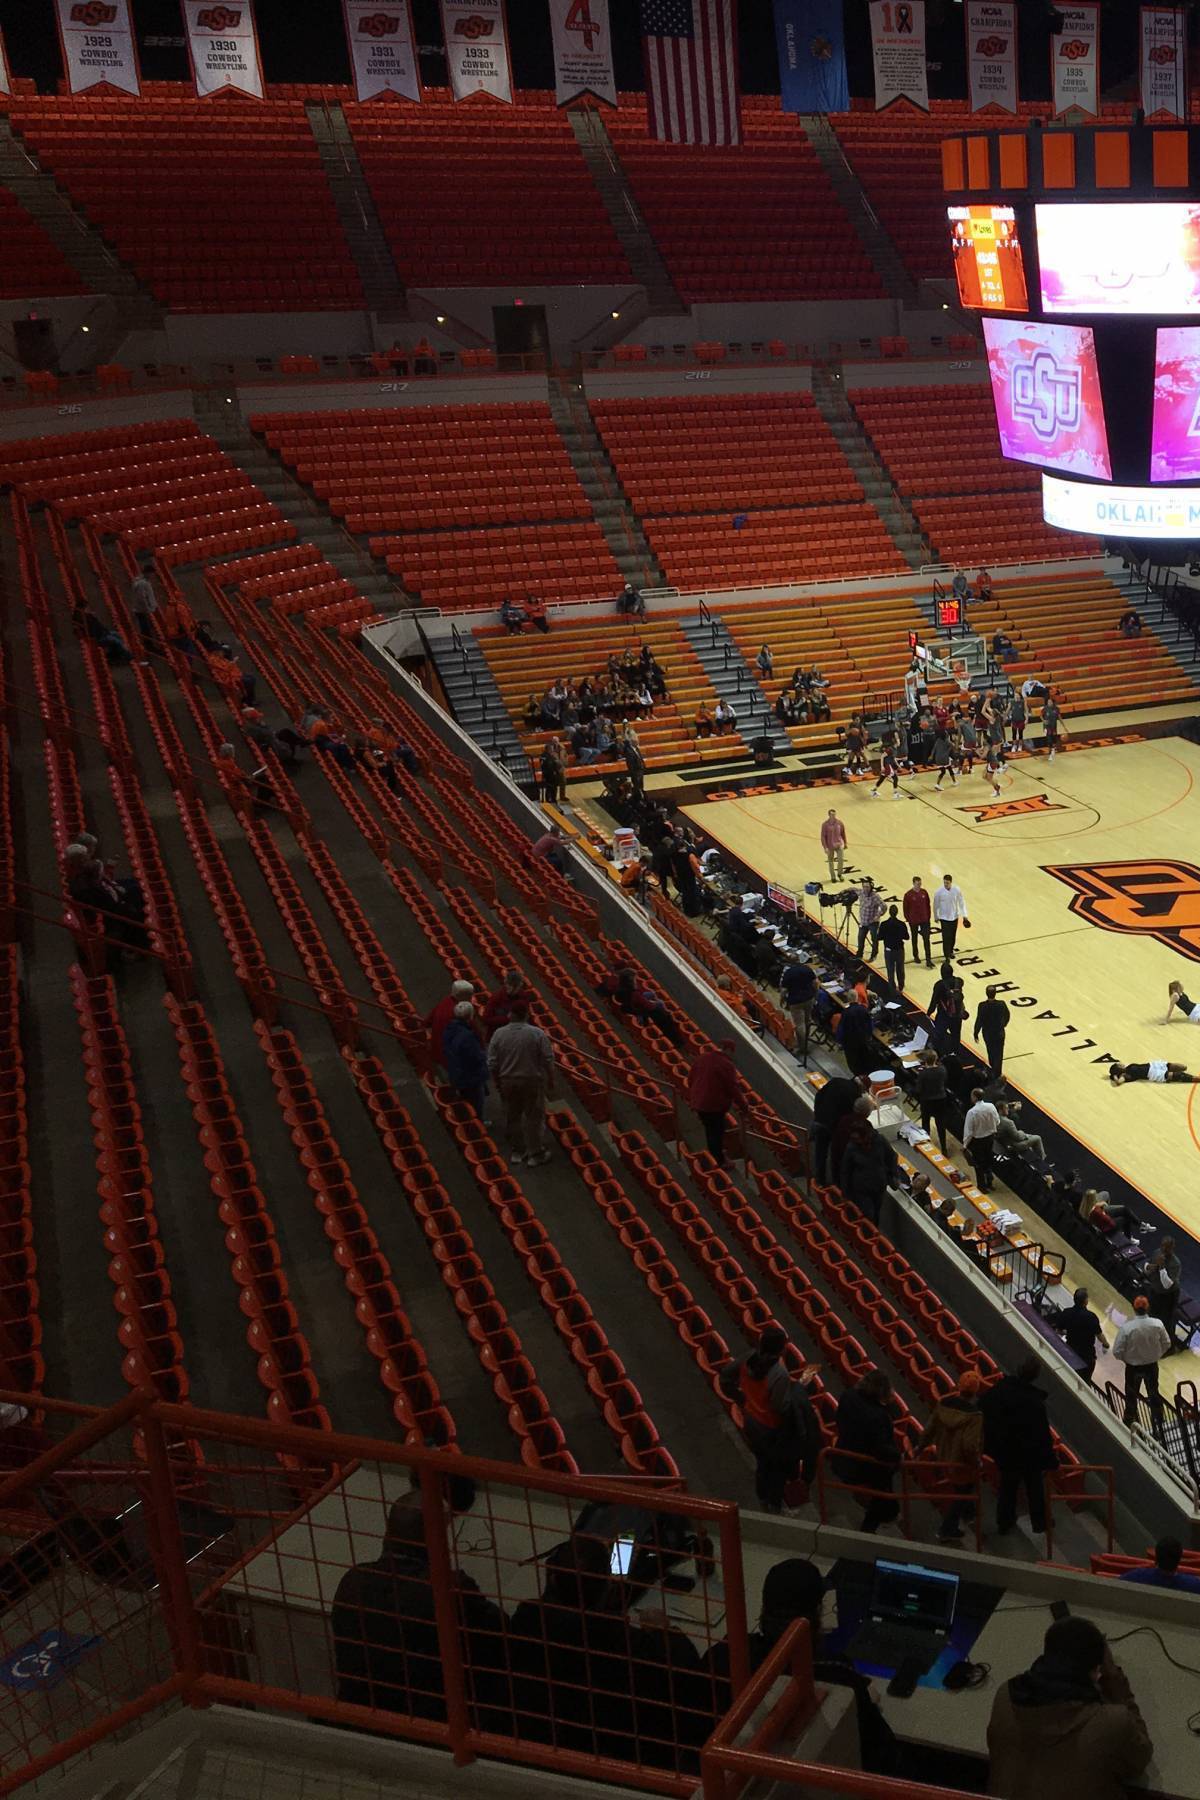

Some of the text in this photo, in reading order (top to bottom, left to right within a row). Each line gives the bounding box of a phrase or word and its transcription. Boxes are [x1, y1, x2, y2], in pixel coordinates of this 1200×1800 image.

[970, 18, 1013, 28] CHAMPIONS
[85, 36, 112, 47] 1929
[210, 40, 236, 51] 1930
[81, 50, 118, 59] COWBOY
[371, 46, 395, 57] 1931
[465, 48, 490, 59] 1933
[80, 59, 123, 67] WRESTLING
[207, 54, 242, 63] COWBOY
[206, 62, 247, 71] WRESTLING
[367, 60, 401, 68] COWBOY
[462, 61, 495, 69] COWBOY
[366, 68, 406, 77] WRESTLING
[461, 69, 499, 77] WRESTLING
[380, 383, 409, 392] 217
[1011, 352, 1082, 442] OSU
[942, 609, 957, 623] 30
